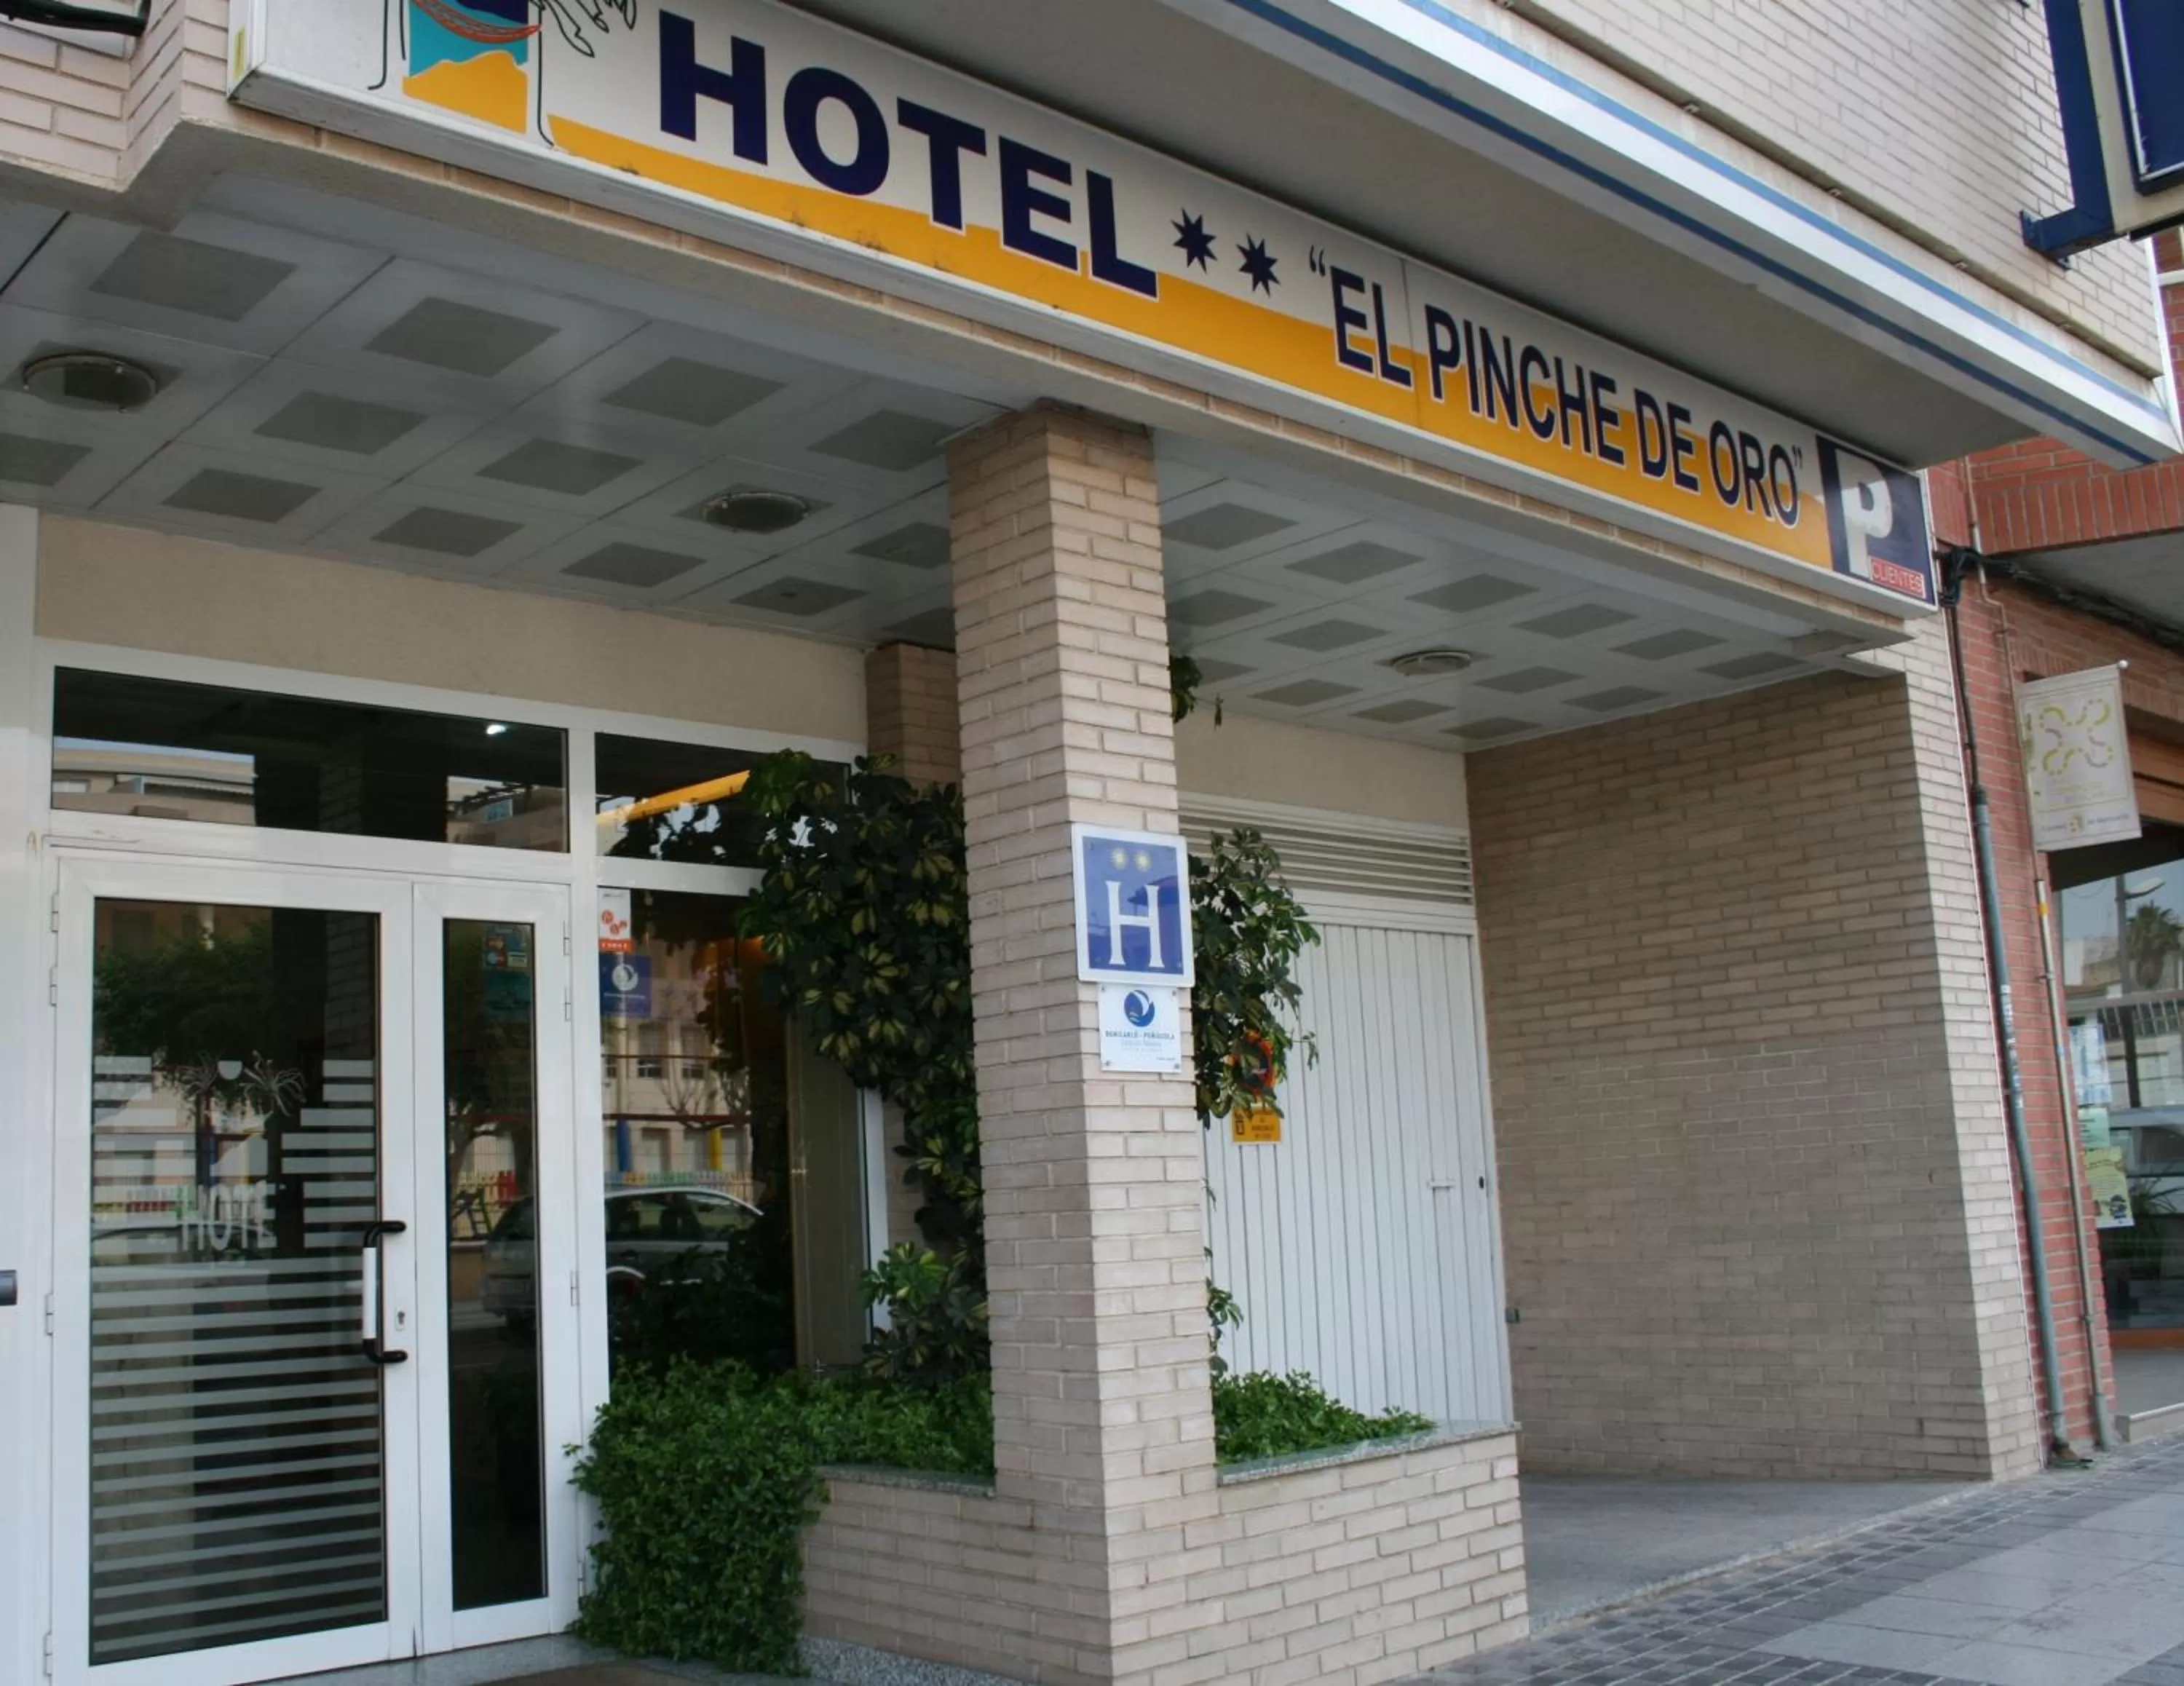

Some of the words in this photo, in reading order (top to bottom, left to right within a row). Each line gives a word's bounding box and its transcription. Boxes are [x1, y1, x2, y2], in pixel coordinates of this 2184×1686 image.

[659, 9, 1158, 299] HOTEL
[1425, 304, 1626, 466] PINCHE
[1634, 387, 1700, 493] DE
[1834, 448, 1893, 578] P
[1873, 561, 1923, 592] CLIENTES
[1105, 880, 1166, 969] H
